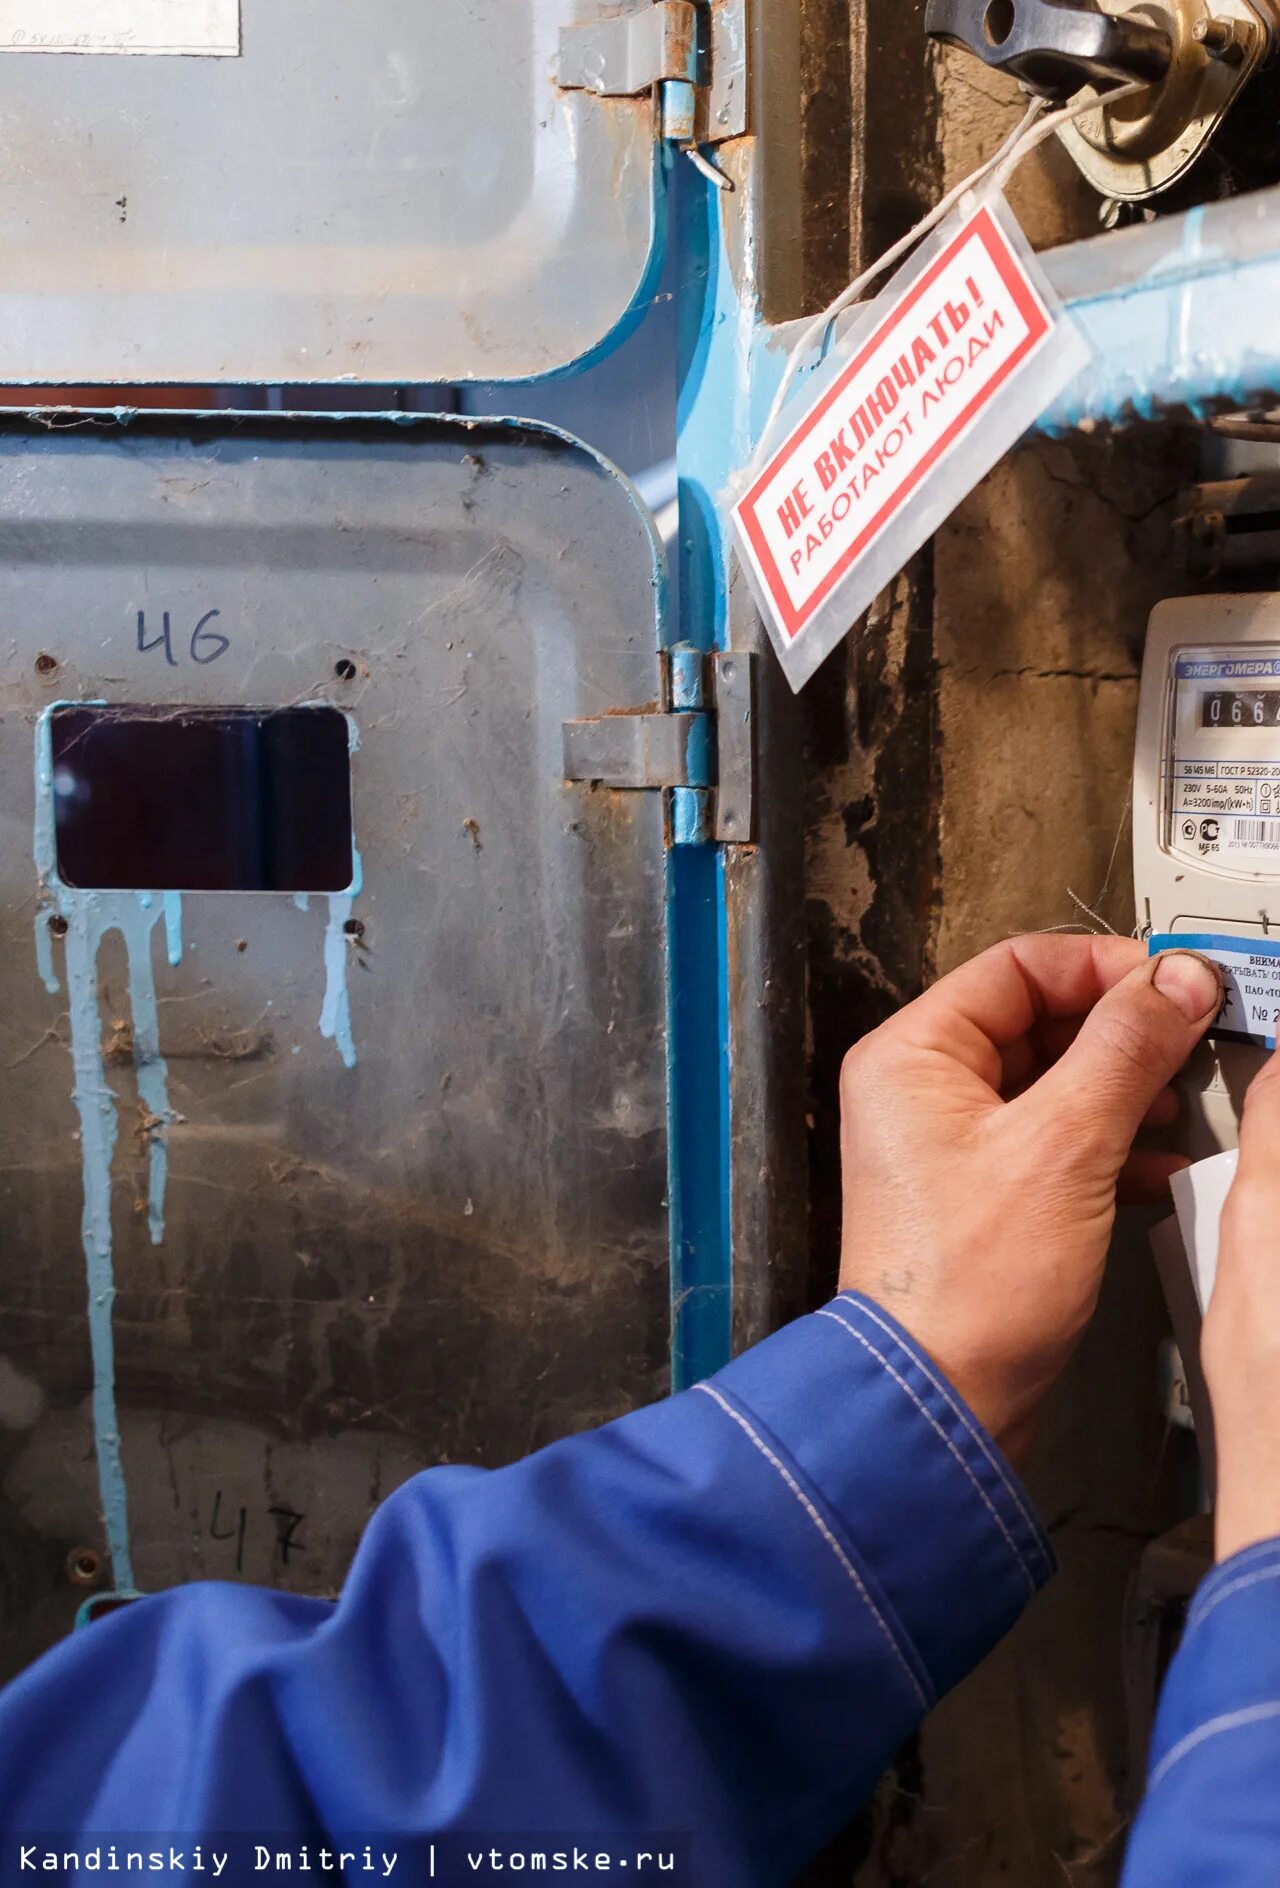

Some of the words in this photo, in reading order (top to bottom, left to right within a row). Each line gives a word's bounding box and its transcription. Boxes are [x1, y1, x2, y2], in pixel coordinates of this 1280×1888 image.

[776, 478, 816, 540] НЕ
[813, 275, 984, 490] ВКЛЮЧАТЬ!
[789, 415, 915, 576] РАБОТАЮТ
[920, 308, 1006, 420] ЛЮДИ
[1221, 766, 1239, 775] ГОСТ
[1183, 783, 1202, 793] 230V
[1206, 785, 1228, 794] 5-60A
[1234, 786, 1254, 795] 50Hz
[1245, 985, 1264, 996] ПАО
[1252, 1005, 1269, 1021] №
[208, 1490, 307, 1572] 47
